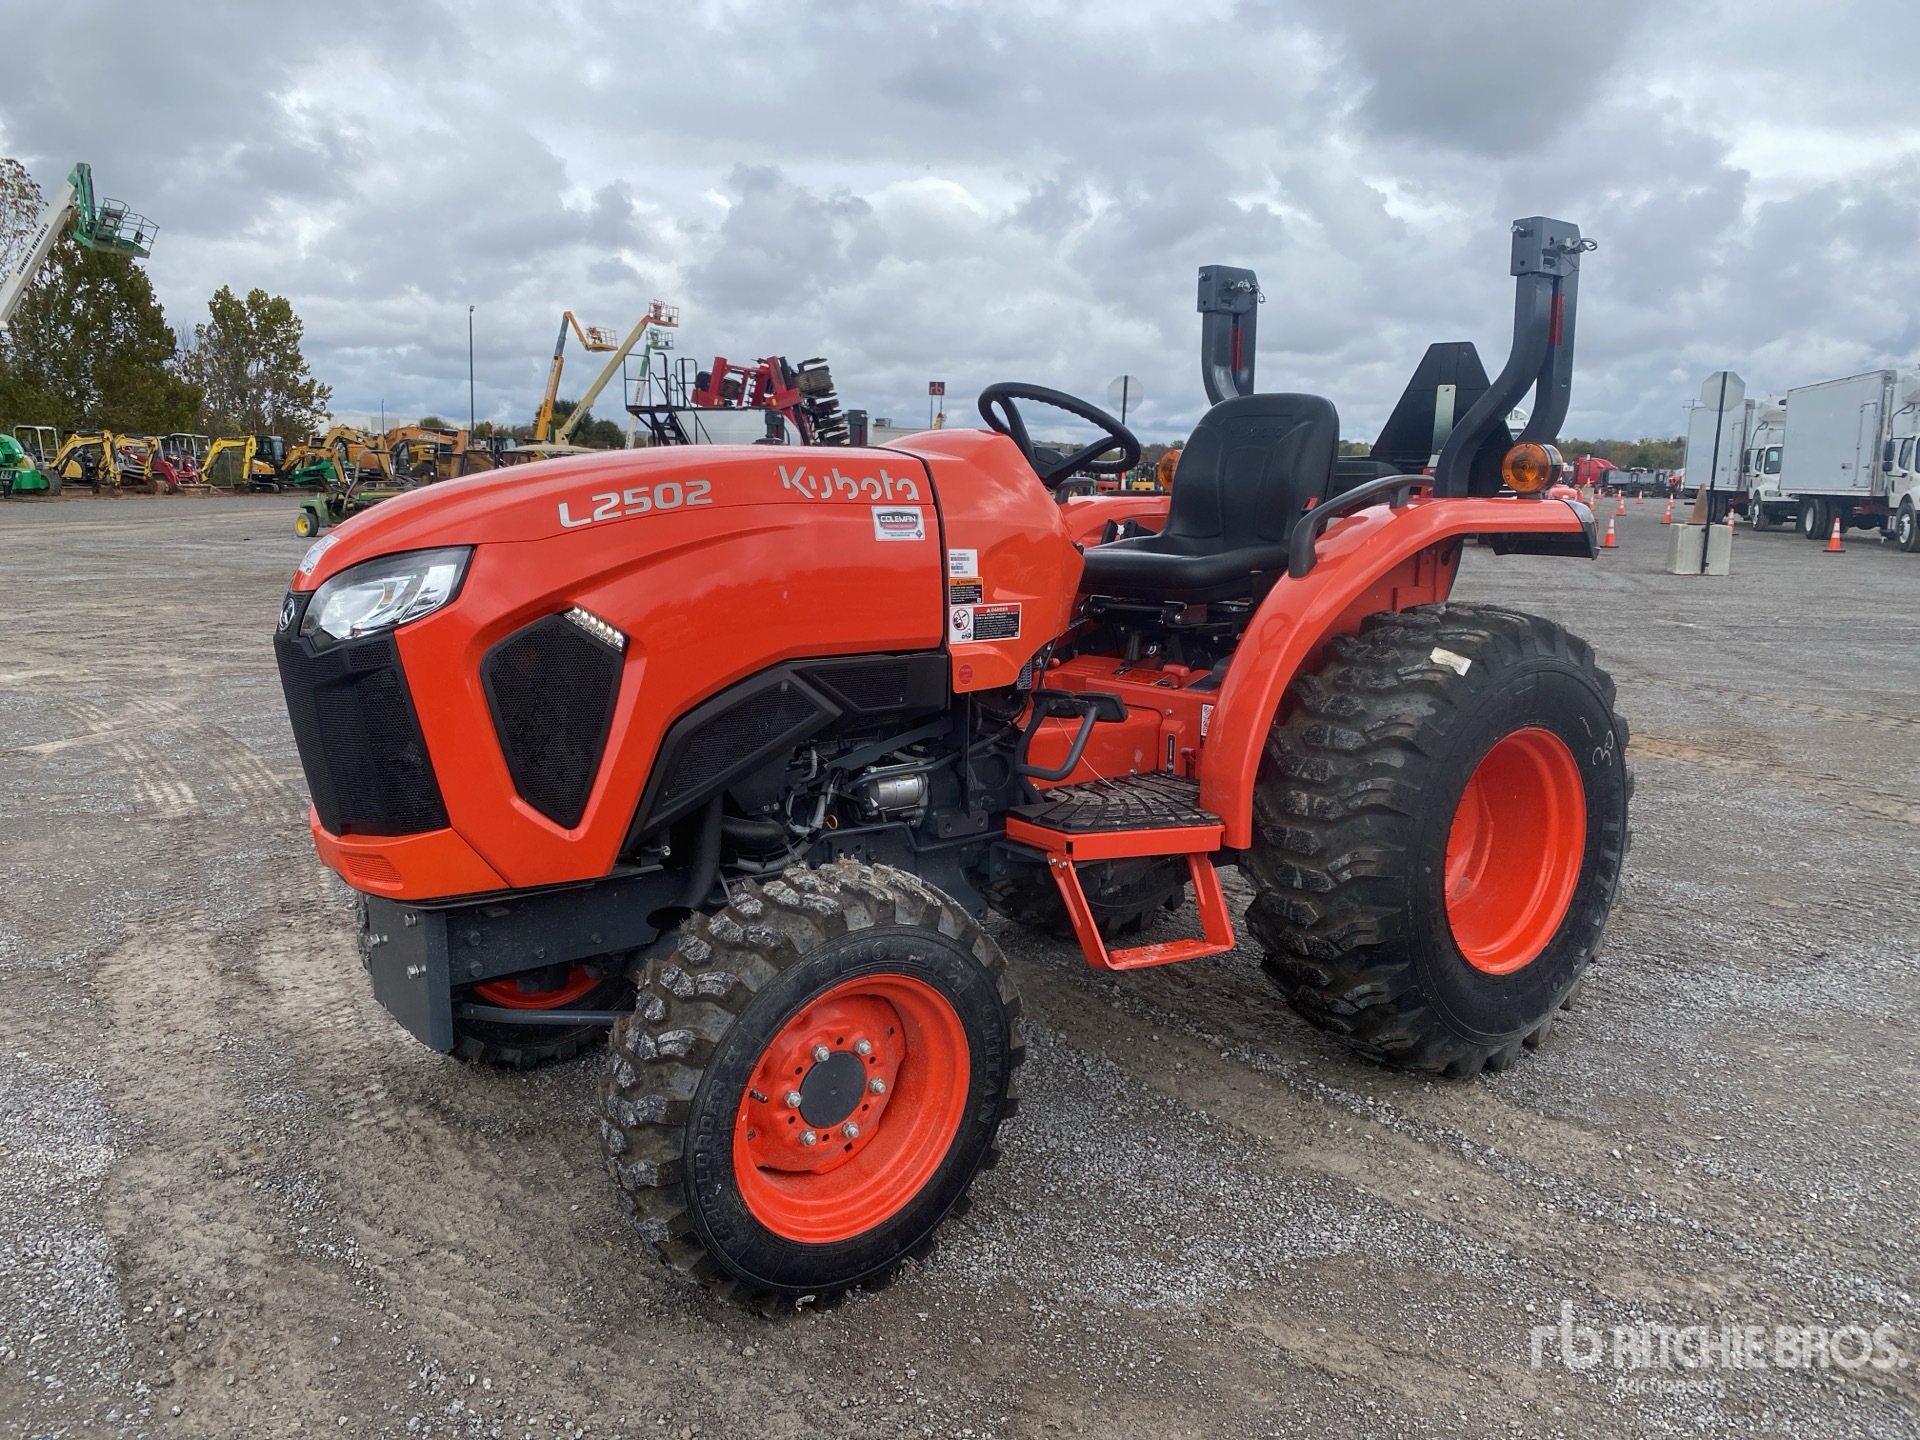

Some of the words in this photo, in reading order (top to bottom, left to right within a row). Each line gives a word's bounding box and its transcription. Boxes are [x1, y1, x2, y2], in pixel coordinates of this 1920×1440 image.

[16, 249, 34, 276] SUNBELT
[31, 222, 49, 250] RENTALS
[558, 480, 713, 528] L2502
[778, 465, 920, 501] Kubota
[880, 515, 917, 523] COLEMAN
